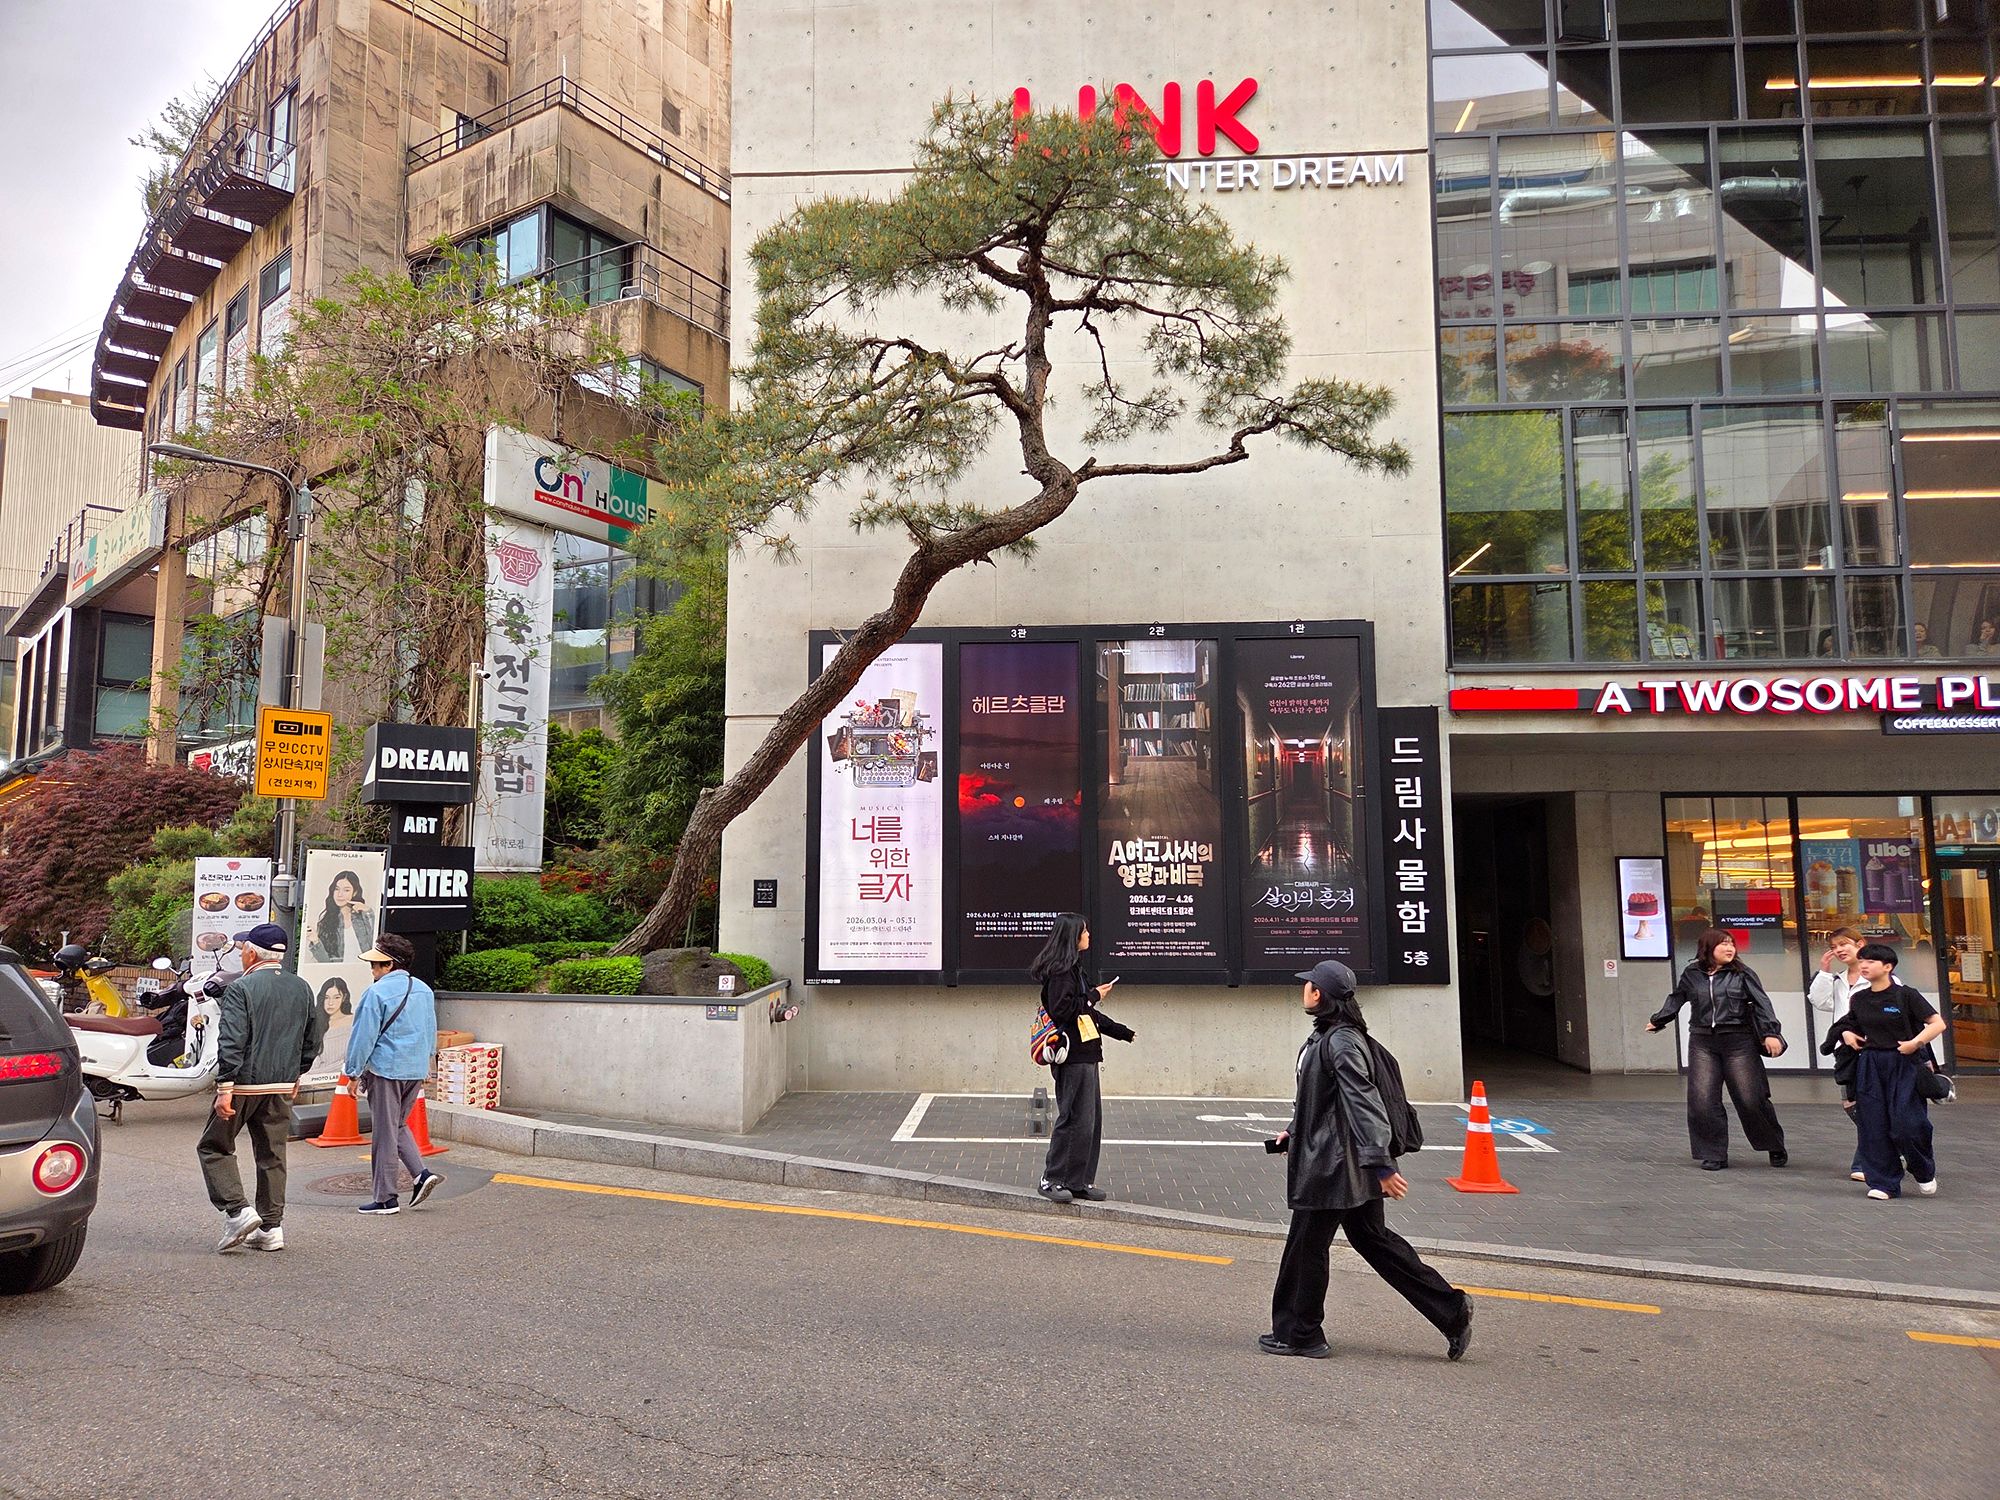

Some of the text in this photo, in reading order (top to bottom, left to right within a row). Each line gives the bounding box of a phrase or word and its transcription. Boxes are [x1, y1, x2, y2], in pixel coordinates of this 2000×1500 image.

[1273, 155, 1405, 190] DREAM
[595, 489, 658, 524] HOUSE
[1011, 628, 1026, 638] 3관
[1149, 626, 1165, 636] 2관
[1289, 624, 1305, 634] 1관
[972, 695, 1066, 714] 헤르츠클란
[1596, 682, 1632, 713] A
[1642, 677, 1921, 712] TWOSOME
[264, 757, 323, 772] 상시단속지역
[381, 747, 469, 772] DREAM
[268, 778, 317, 789] (견인지역)
[403, 816, 438, 834] ART
[851, 816, 903, 844] 너를
[870, 848, 910, 869] 위한
[1108, 837, 1213, 865] A여고 사서의
[1868, 842, 1911, 857] ube
[382, 868, 469, 898] CENTER
[1117, 863, 1203, 888] 영광과 비극
[857, 873, 913, 903] 글자
[1129, 895, 1166, 903] 2026.1.27
[1176, 895, 1194, 903] 4.26
[1251, 886, 1354, 912] 살인의 흔적
[1403, 951, 1429, 966] 5층
